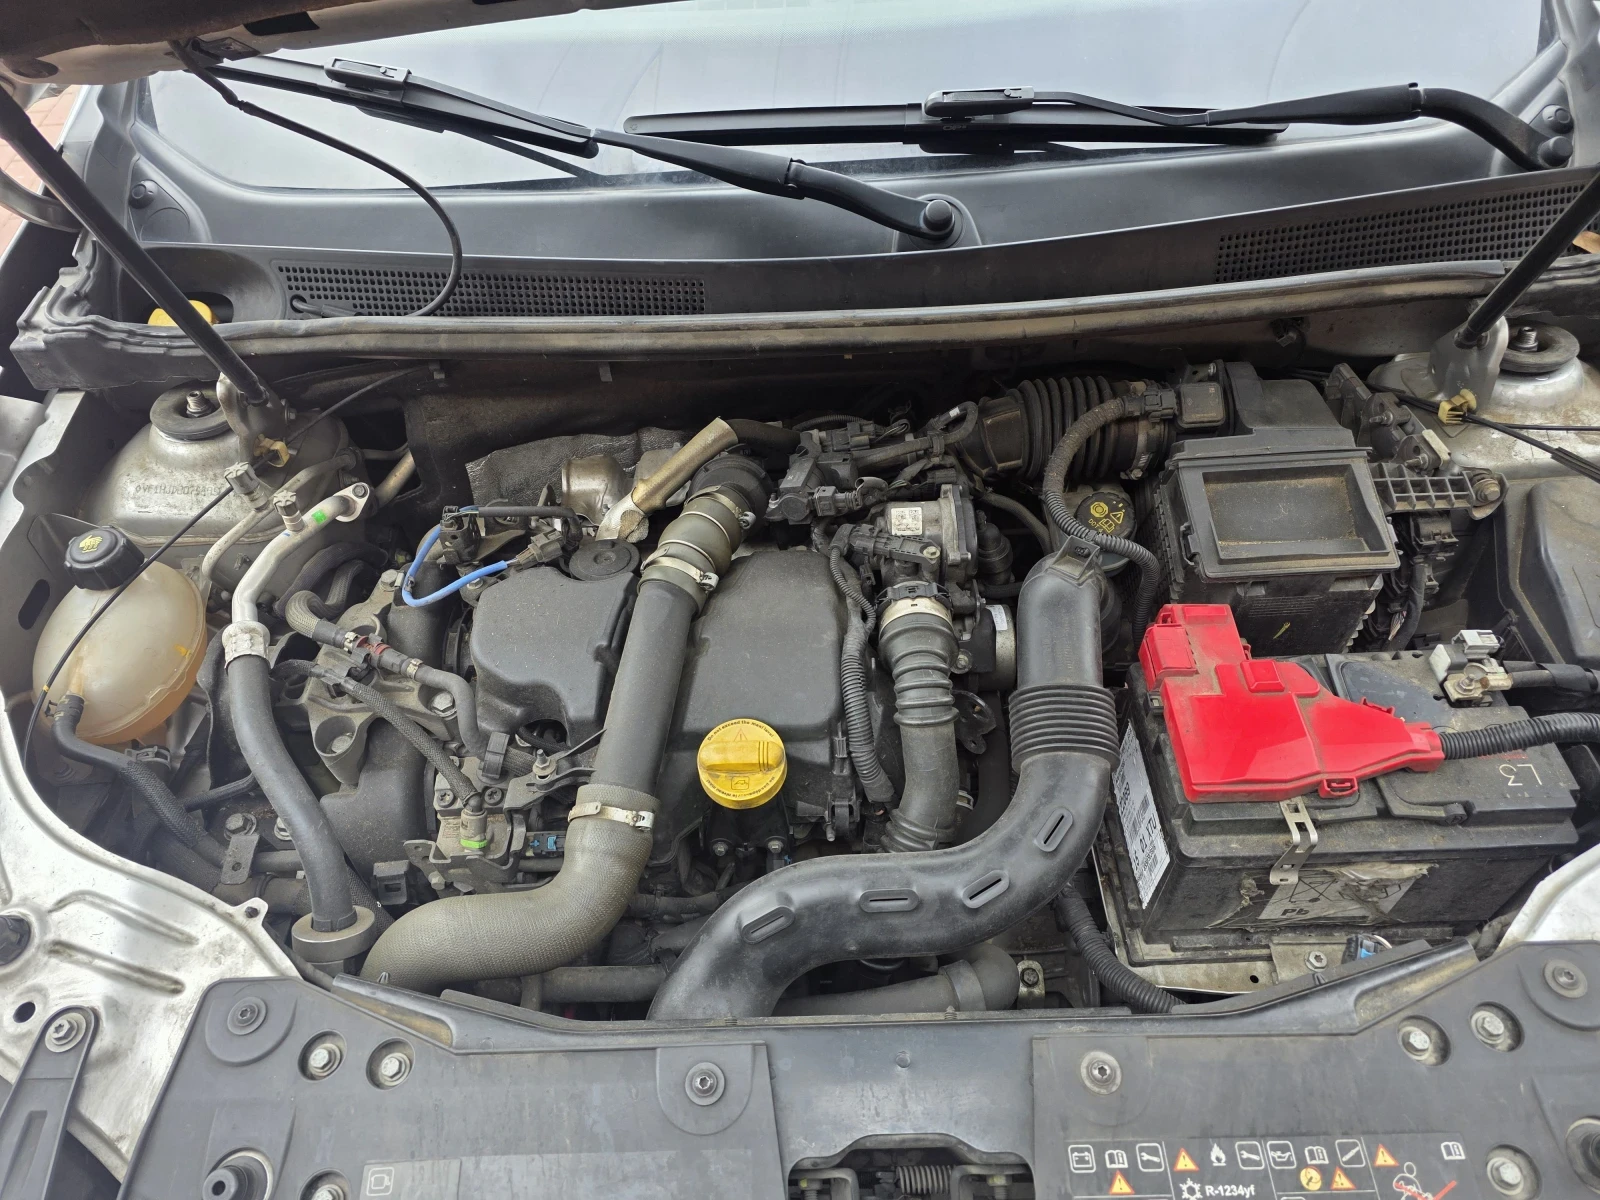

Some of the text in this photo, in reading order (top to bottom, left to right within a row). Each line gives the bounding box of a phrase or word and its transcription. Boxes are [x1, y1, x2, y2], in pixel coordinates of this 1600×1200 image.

[1088, 518, 1100, 529] DOT
[714, 727, 722, 735] not
[722, 720, 741, 729] exceed
[1498, 763, 1543, 787] L3
[1280, 907, 1310, 917] Pb
[1204, 1184, 1256, 1199] R-1234yf
